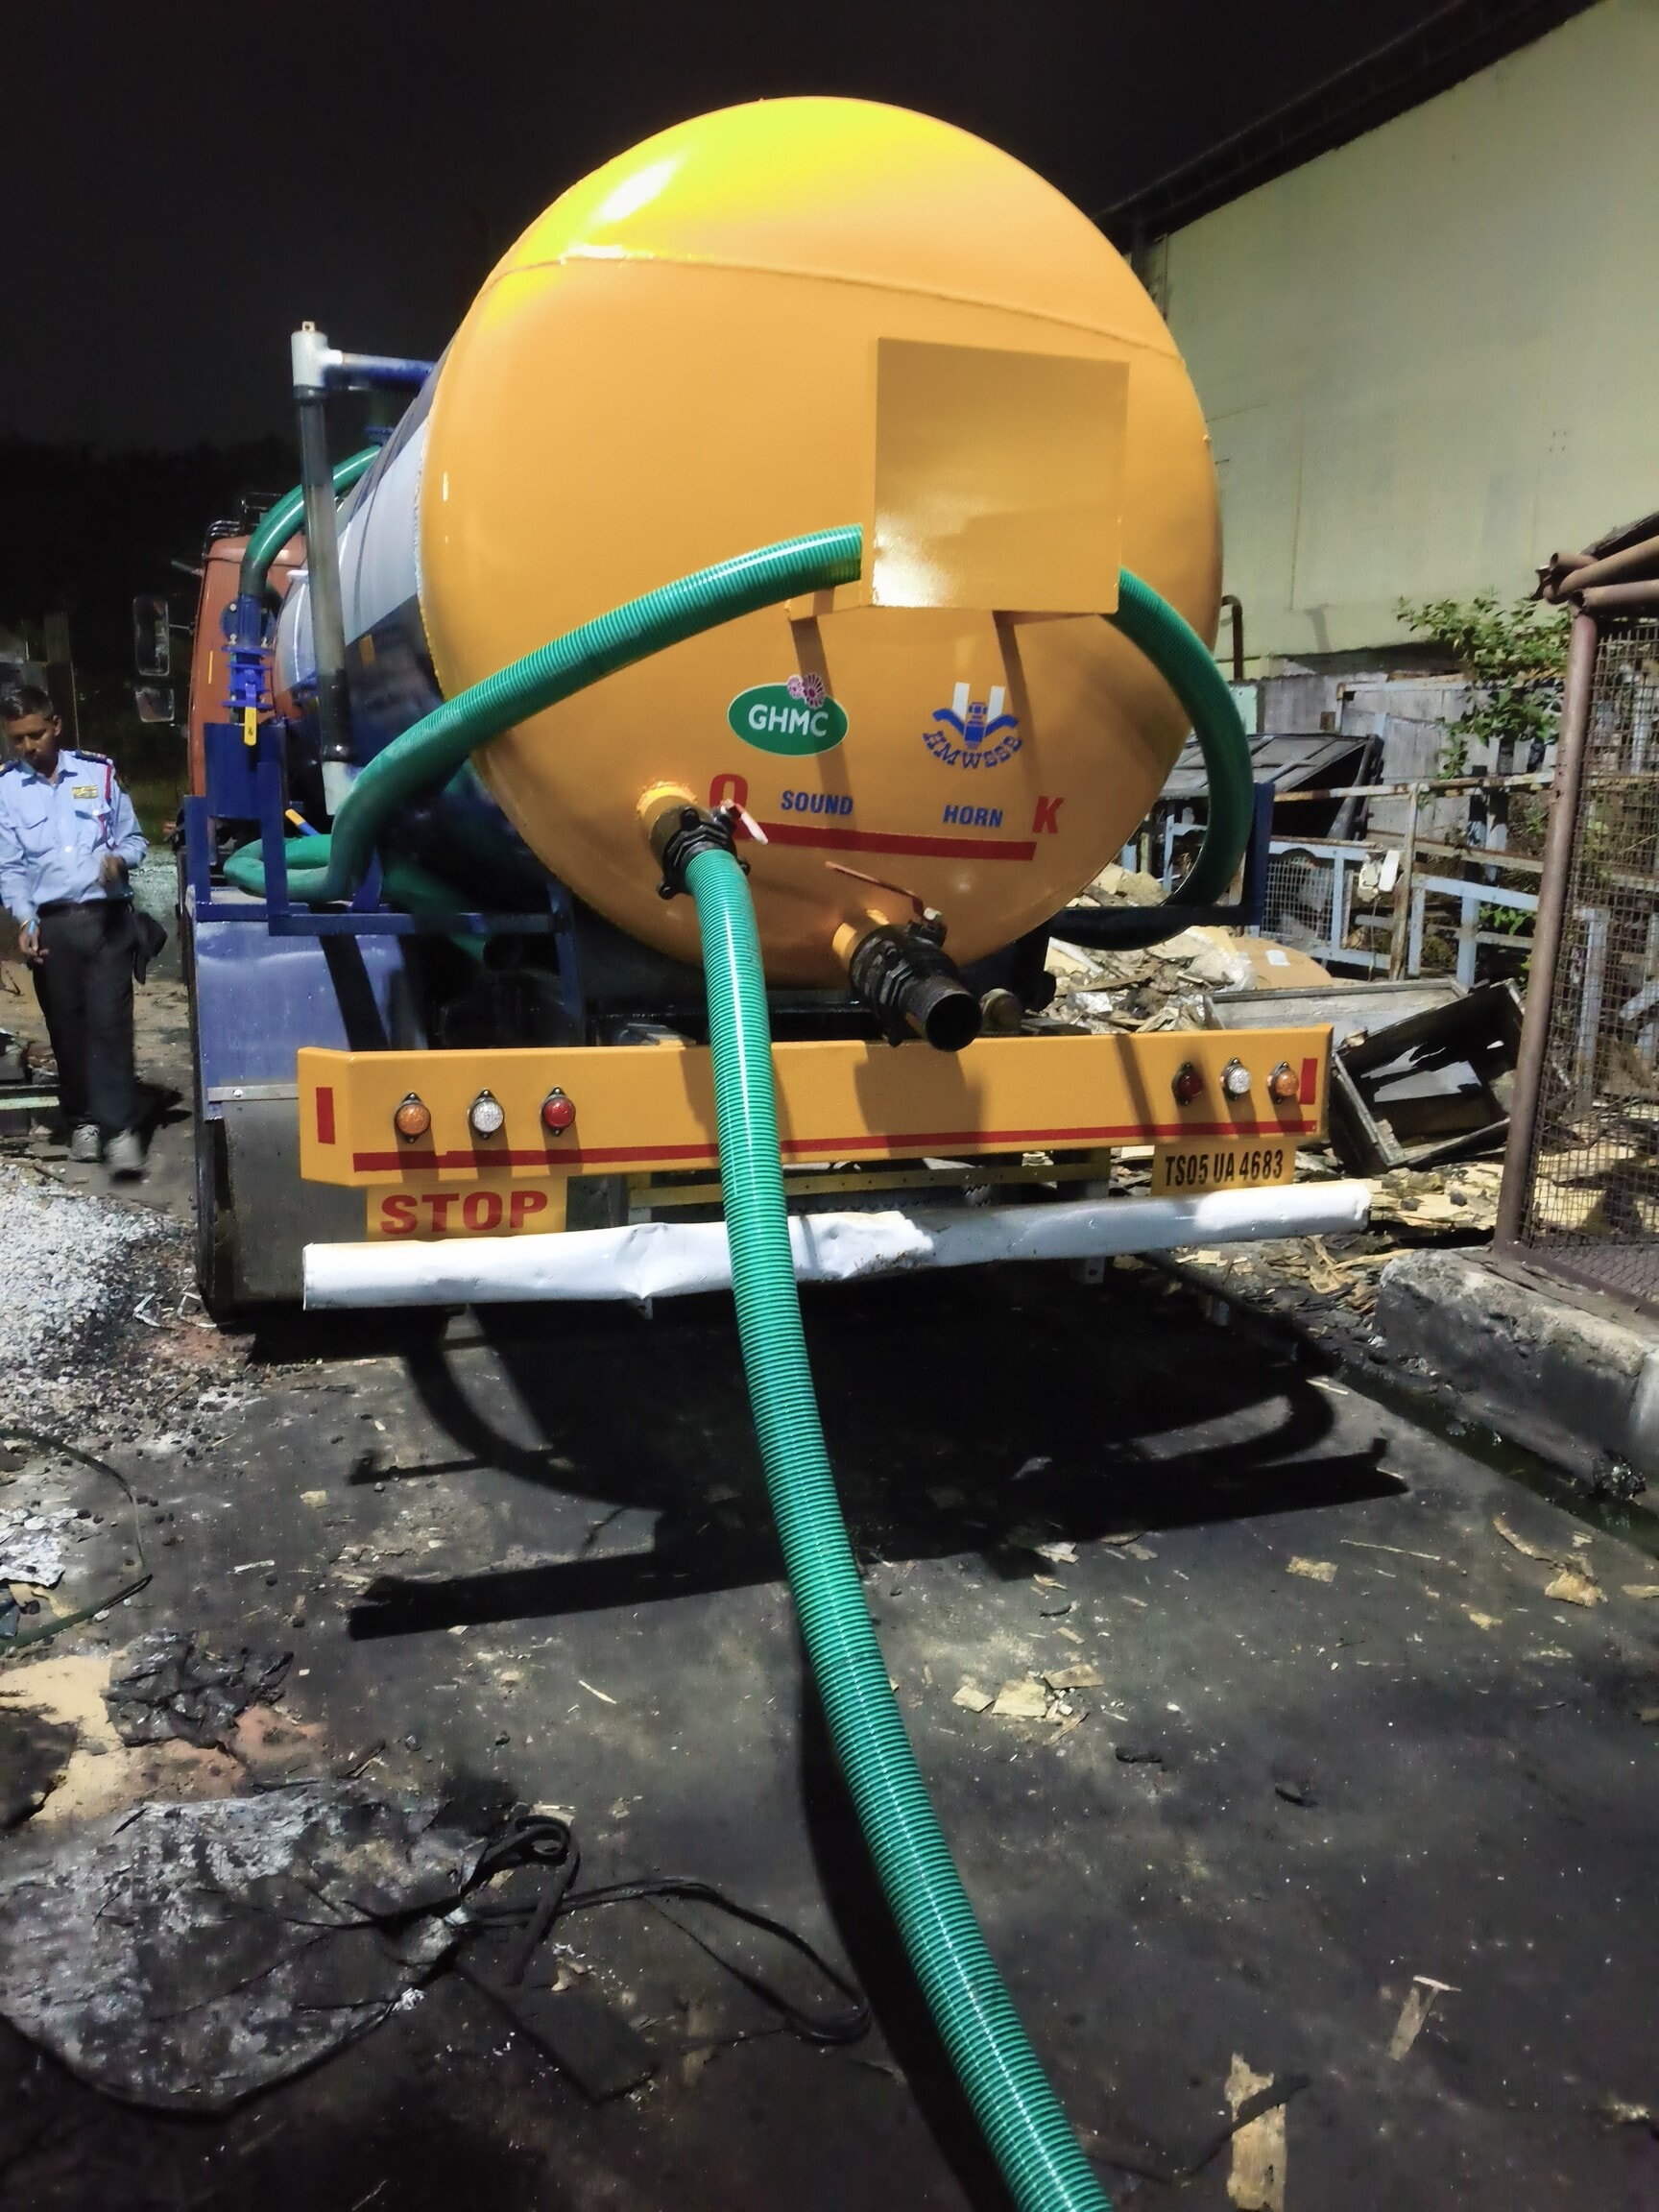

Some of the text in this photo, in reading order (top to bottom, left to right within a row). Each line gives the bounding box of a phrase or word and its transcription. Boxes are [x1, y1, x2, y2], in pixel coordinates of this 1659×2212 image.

[748, 704, 829, 738] GHMC
[781, 790, 854, 816] SOUND
[943, 805, 1003, 829] HORN
[1032, 795, 1067, 834] K
[1165, 1149, 1285, 1187] TS05 UA 4683
[380, 1190, 548, 1236] STOP
